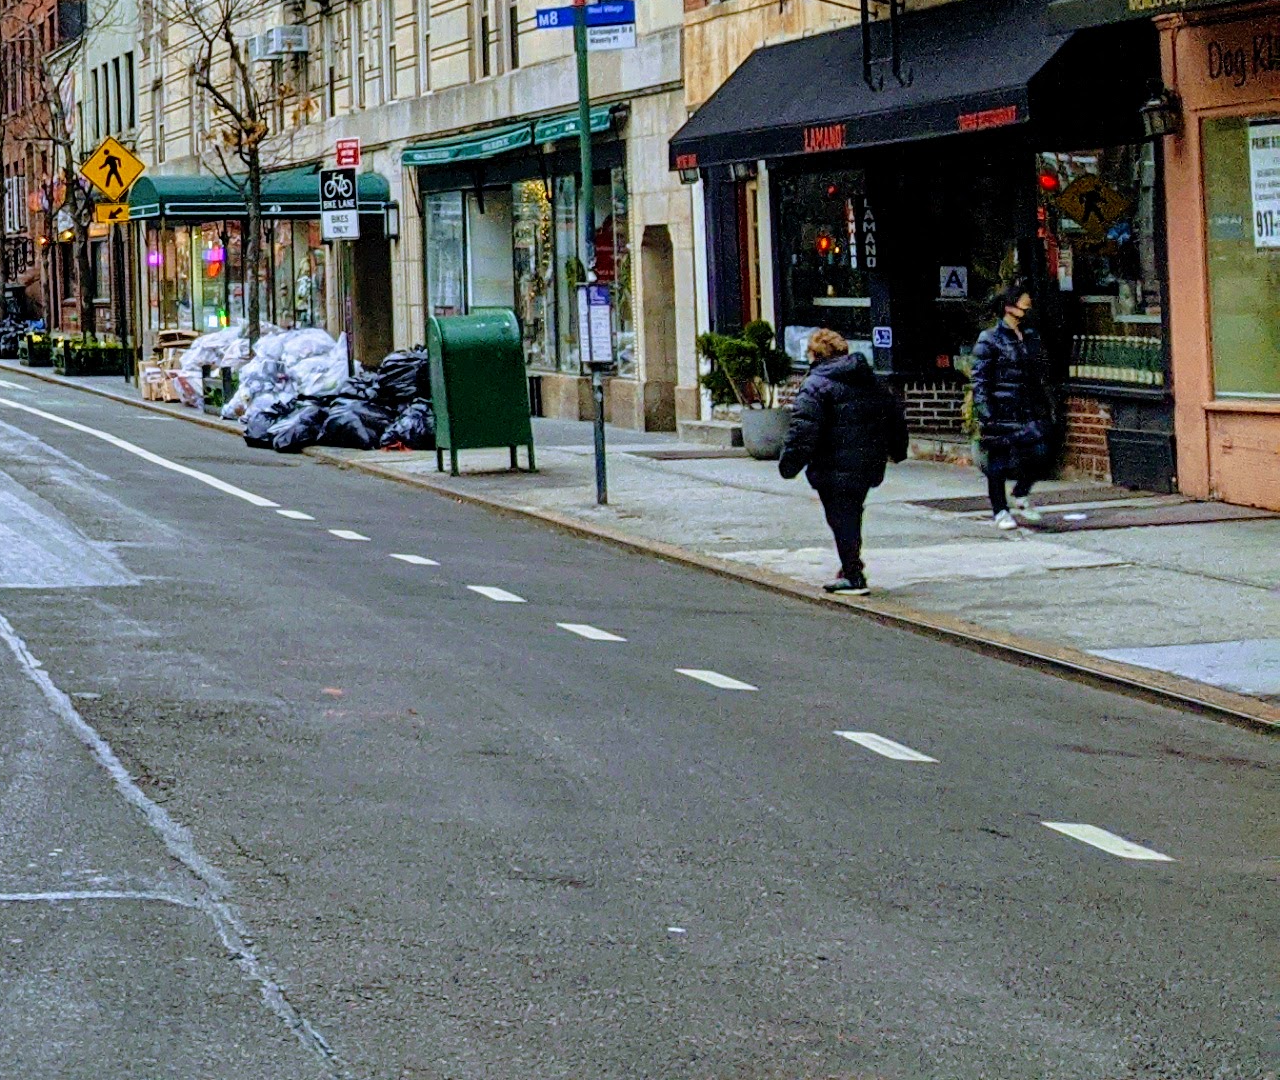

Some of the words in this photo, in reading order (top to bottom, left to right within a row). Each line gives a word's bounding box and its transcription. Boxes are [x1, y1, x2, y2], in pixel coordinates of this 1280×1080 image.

[538, 10, 559, 26] M8
[1208, 40, 1246, 87] Dog
[804, 123, 847, 153] LAMANO
[323, 200, 337, 210] BIKE
[338, 199, 355, 209] LANE
[331, 215, 349, 224] BIKES
[333, 225, 349, 234] ONLY
[862, 198, 877, 268] LAMANO
[945, 269, 963, 289] A
